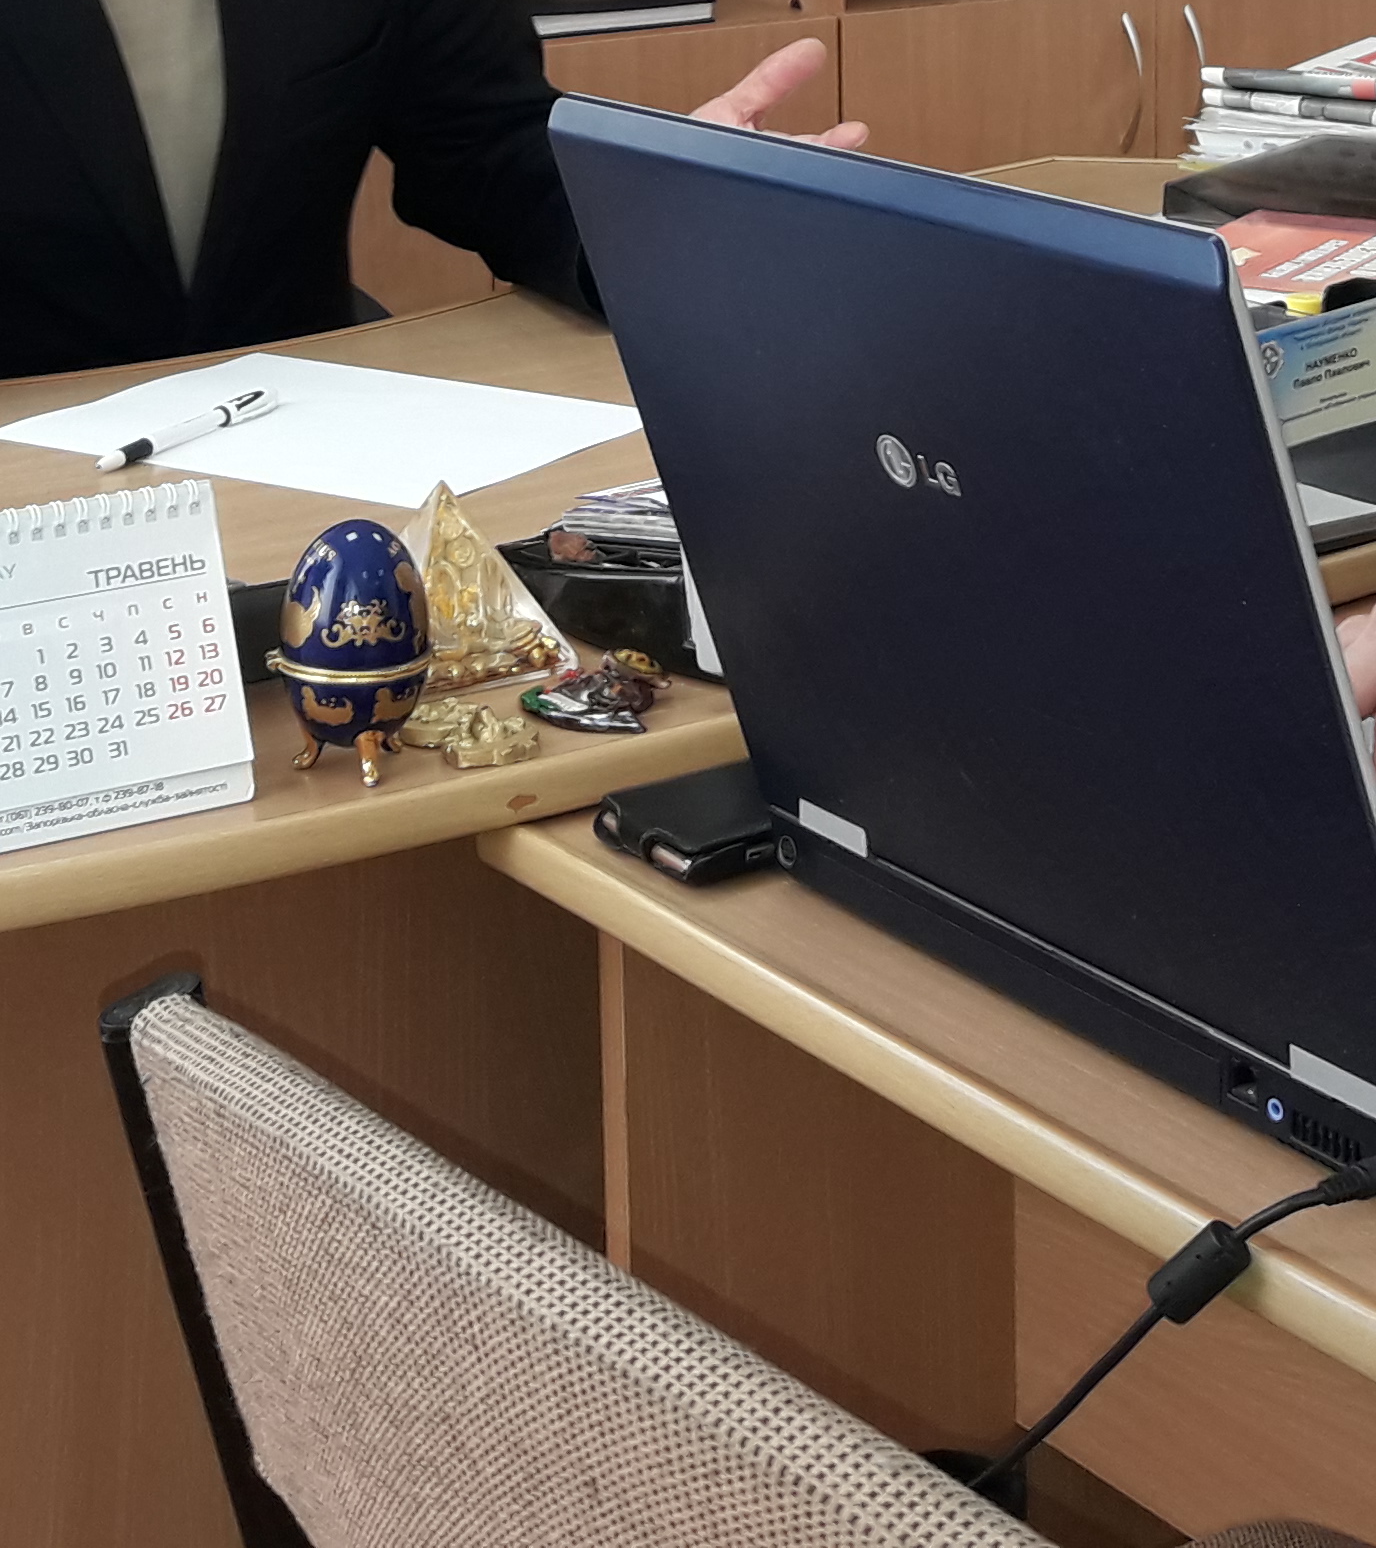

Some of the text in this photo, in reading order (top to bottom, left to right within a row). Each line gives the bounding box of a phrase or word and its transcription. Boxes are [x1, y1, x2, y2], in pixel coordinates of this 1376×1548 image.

[916, 454, 962, 497] LG
[86, 553, 206, 589] ТРАВЕНЬ
[36, 617, 215, 665] 1 2 3 4 5 6
[1, 642, 219, 699] 7 8 9 10 11 12 13
[31, 701, 52, 720] 15
[65, 694, 86, 713] 16
[102, 687, 120, 706] 17
[135, 681, 156, 700] 18
[169, 674, 189, 693] 19
[197, 668, 223, 688] 20
[1, 693, 227, 753] 21 22 23 24 25 26 27
[32, 753, 60, 774] 29
[67, 747, 94, 768] 30
[108, 739, 129, 759] 31
